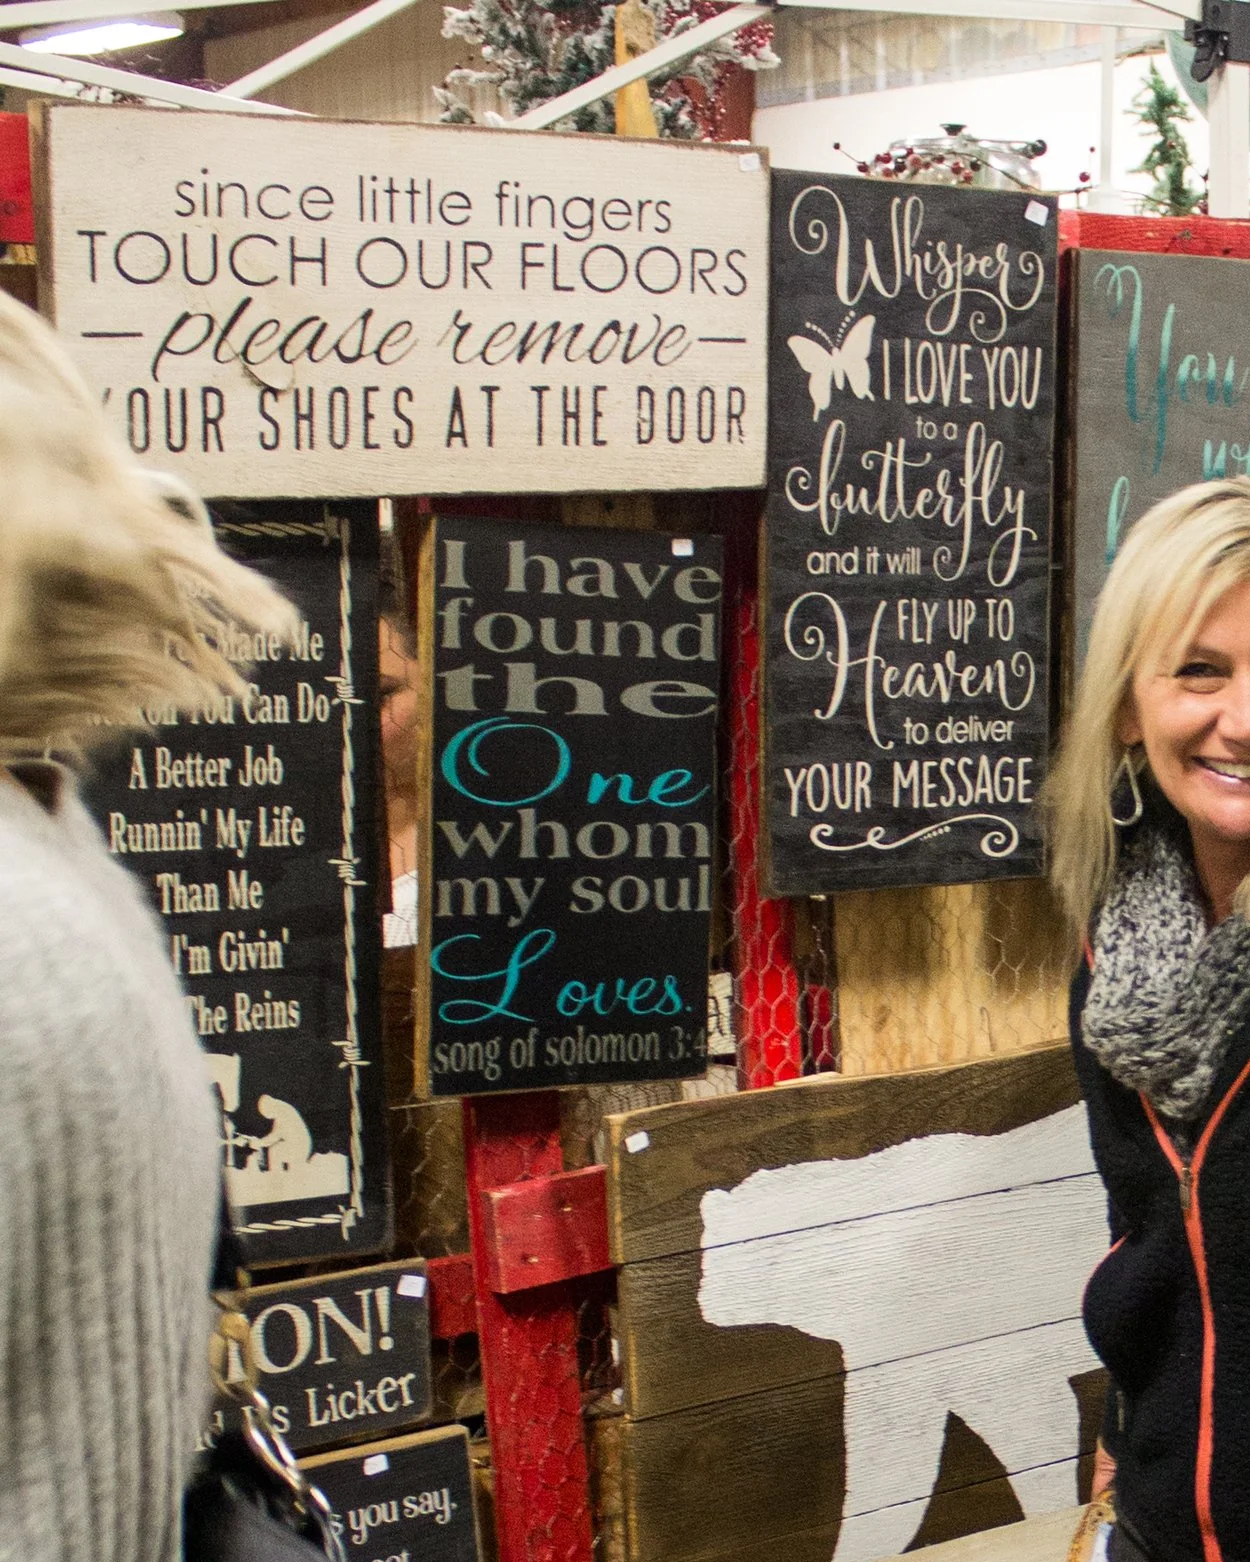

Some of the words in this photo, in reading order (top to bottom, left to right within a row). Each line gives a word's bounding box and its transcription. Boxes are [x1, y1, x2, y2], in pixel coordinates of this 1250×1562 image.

[174, 168, 335, 221] since
[358, 174, 472, 227] little
[495, 181, 673, 241] fingers
[77, 229, 327, 287] TOUCH
[355, 236, 494, 290] OUR
[520, 242, 748, 297] FLOORS
[789, 185, 1044, 342] Whisper
[152, 297, 418, 381] please
[437, 308, 694, 367] remove
[882, 339, 890, 399] I
[904, 341, 973, 405] LOVE
[981, 347, 1042, 409] YOU
[101, 387, 225, 454] OUR
[258, 385, 415, 450] SHOES
[445, 385, 500, 449] AT
[530, 385, 608, 447] THE
[636, 385, 746, 445] DOOR
[916, 416, 937, 439] to
[943, 423, 957, 439] a
[785, 419, 1037, 587] butterfly
[440, 539, 470, 589] I
[505, 540, 721, 604] have
[807, 547, 858, 575] and
[866, 547, 878, 575] it
[887, 547, 921, 574] will
[437, 597, 716, 661] found
[897, 599, 938, 644] FLY
[949, 599, 975, 644] UP
[985, 599, 1014, 641] TO
[436, 662, 717, 718] the
[784, 591, 1035, 749] Heaven
[242, 683, 290, 724] Can
[297, 682, 330, 723] Do
[903, 717, 928, 744] to
[936, 716, 1014, 743] deliver
[128, 748, 148, 789] A
[155, 747, 232, 788] Better
[239, 745, 284, 787] Job
[441, 716, 711, 807] One
[784, 761, 871, 817] YOUR
[893, 755, 1033, 808] MESSAGE
[109, 808, 208, 853] Runnin'
[216, 808, 252, 858] My
[258, 806, 305, 847] Life
[437, 808, 710, 859] whom
[157, 873, 220, 913] Than
[228, 870, 263, 910] Me
[435, 876, 545, 927] my
[569, 865, 711, 913] soul
[172, 934, 212, 975] I'm
[219, 927, 289, 972] Givin'
[430, 929, 692, 1024] Loves.
[235, 990, 300, 1032] Reins
[434, 1036, 500, 1081] song
[510, 1028, 539, 1068] of
[545, 1025, 659, 1066] solomon
[305, 1373, 416, 1427] Licker
[348, 1501, 400, 1545] you
[402, 1487, 457, 1524] say.
